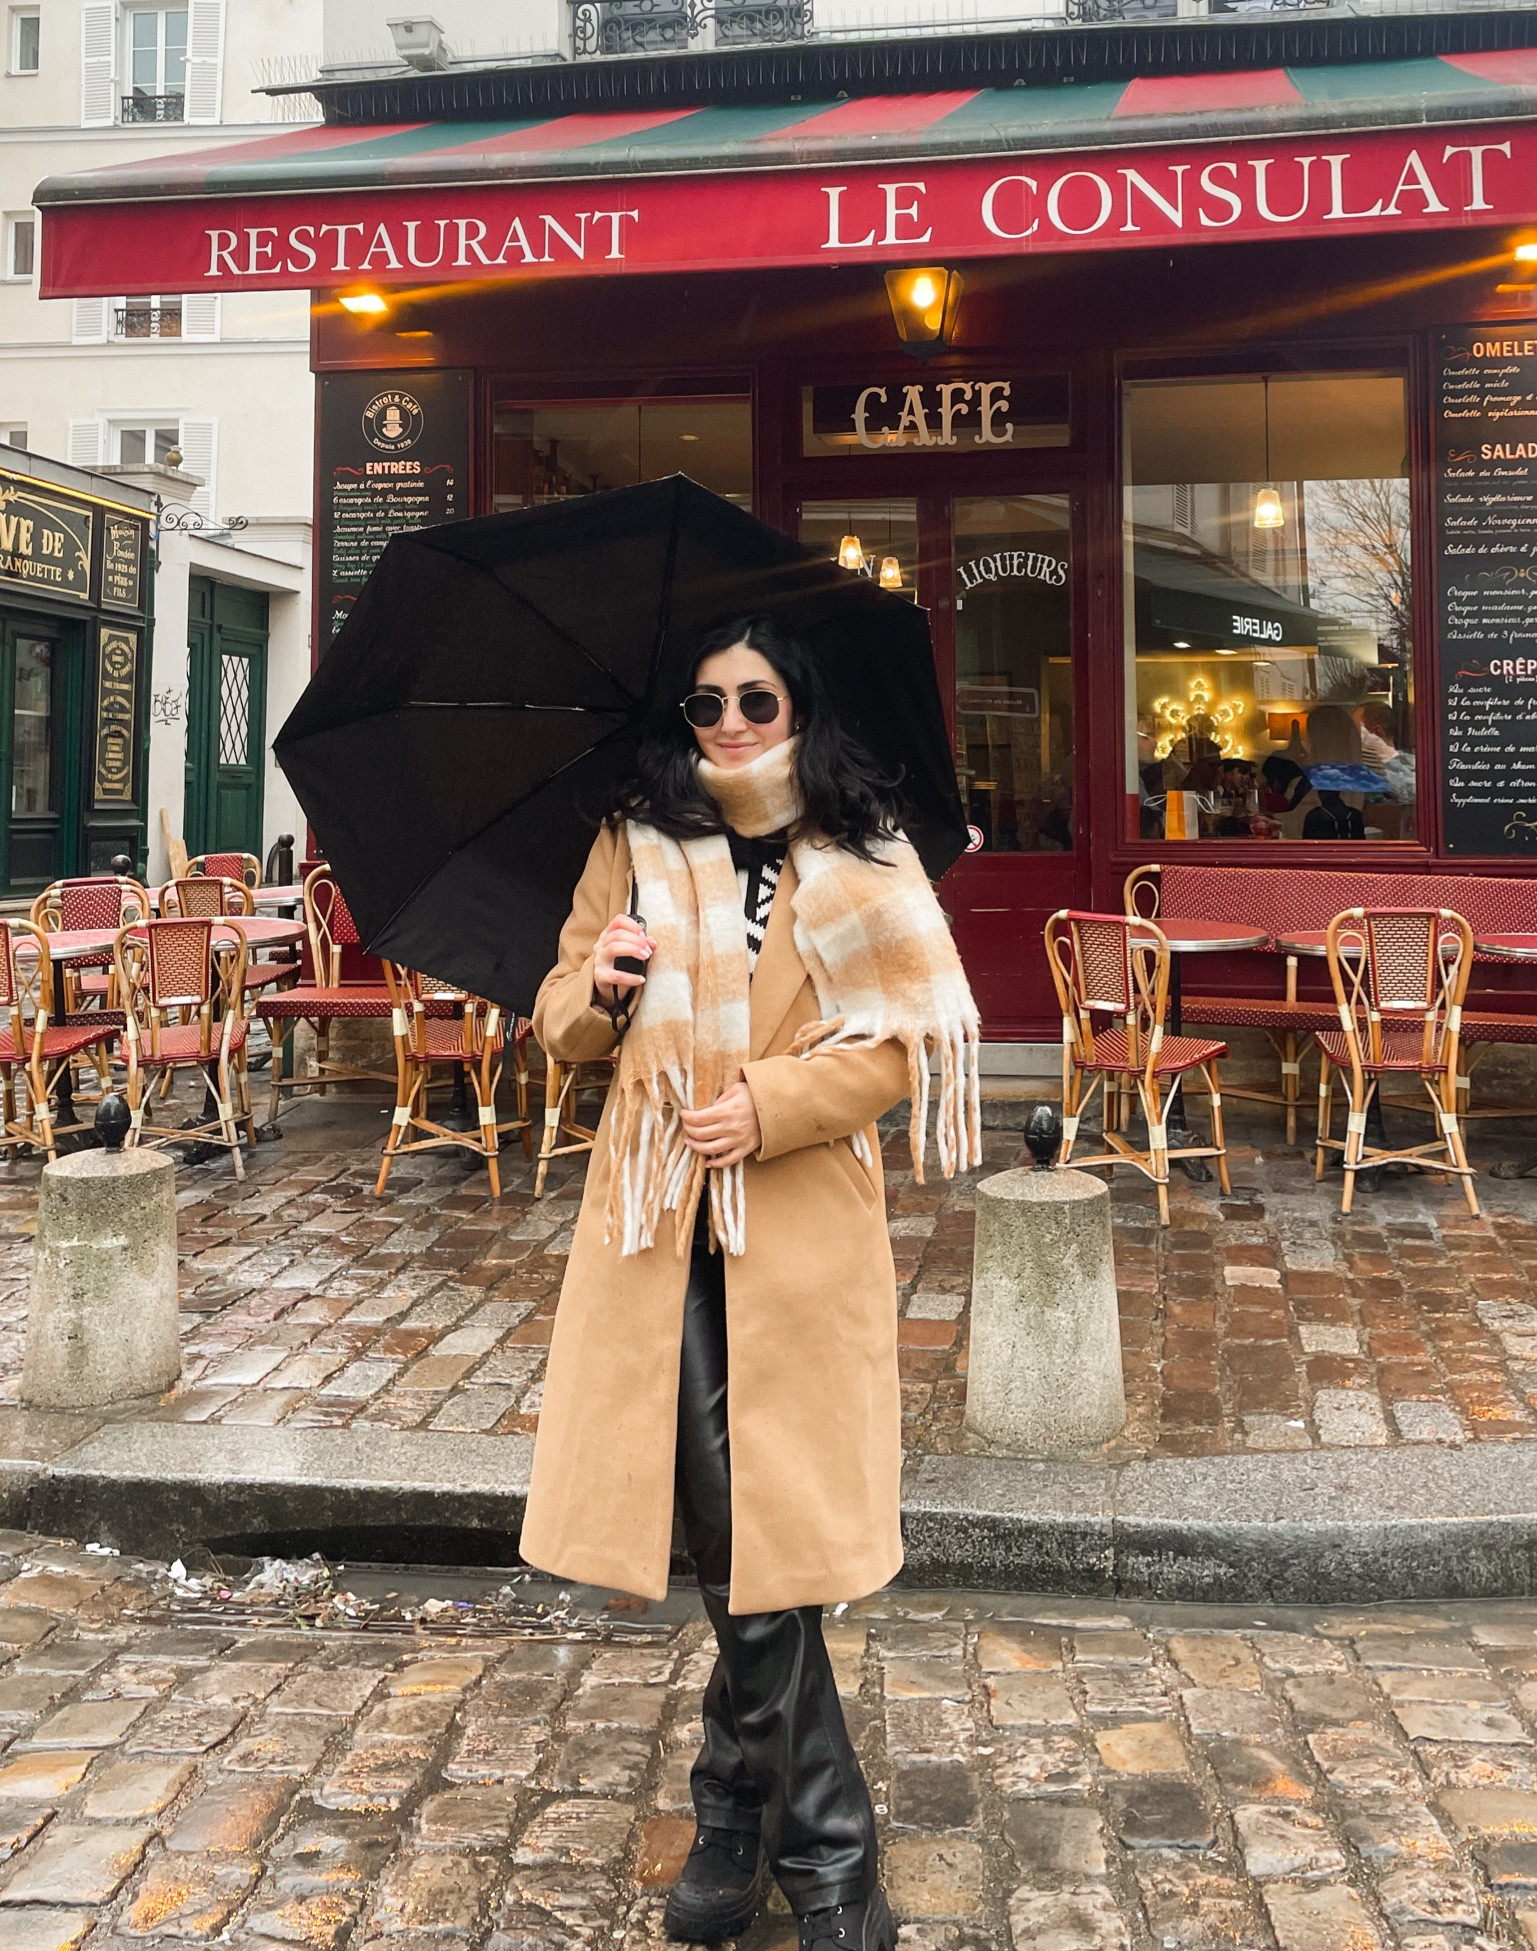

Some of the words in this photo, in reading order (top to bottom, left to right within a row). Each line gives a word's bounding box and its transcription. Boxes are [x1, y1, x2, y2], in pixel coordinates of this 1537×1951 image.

[821, 181, 932, 249] LE
[980, 141, 1511, 239] CONSULAT
[204, 209, 639, 277] RESTAURANT
[1472, 340, 1537, 358] OMELE
[1443, 367, 1480, 376] Omelette
[1443, 380, 1480, 390] Omelette
[1484, 379, 1509, 388] mixte
[365, 394, 392, 419] Bistrot
[393, 394, 401, 403] &
[402, 396, 420, 416] Café
[1443, 394, 1480, 404] Omelette
[1482, 394, 1522, 407] fromage
[1443, 409, 1481, 418] Omelette
[373, 437, 395, 450] Depuis
[365, 461, 421, 475] ENTRÉES
[1444, 468, 1475, 478] Salade
[1479, 469, 1491, 477] du
[1493, 467, 1529, 477] Consulat
[333, 480, 358, 492] Soupe
[360, 481, 365, 489] à
[366, 480, 394, 491] l'oignon
[396, 479, 424, 491] gratinée
[333, 496, 338, 504] 6
[339, 495, 372, 506] escargots
[374, 495, 383, 503] de
[386, 494, 430, 506] Bourgogne
[1444, 493, 1475, 503] Salade
[1479, 493, 1534, 507] végétarienne
[334, 511, 340, 519] 12
[342, 509, 374, 520] escargots
[376, 509, 385, 518] de
[388, 509, 429, 520] Bourgogne
[1444, 517, 1478, 527] Salade
[333, 524, 364, 533] Saumon
[41, 528, 65, 558] DE
[334, 539, 357, 548] Terrine
[360, 539, 368, 547] de
[1444, 544, 1476, 555] Salade
[1478, 544, 1488, 554] de
[1490, 543, 1518, 554] chèvre
[106, 541, 136, 560] Fondée
[333, 554, 360, 562] Cuisses
[361, 554, 370, 562] de
[332, 569, 367, 577] L'assiette
[957, 551, 1068, 590] LIQUEURS
[113, 588, 126, 598] FILS
[1447, 586, 1478, 602] Croque
[1447, 602, 1478, 616] Croque
[1447, 615, 1479, 629] Croque
[1447, 629, 1484, 639] Assiette
[1487, 630, 1498, 639] de
[1501, 630, 1508, 639] 3
[1489, 657, 1537, 676] CRÊP
[1448, 683, 1463, 693] Au
[1467, 685, 1493, 693] sucre
[1460, 696, 1471, 706] la
[1472, 697, 1511, 711] confiture
[1514, 697, 1525, 706] de
[1459, 711, 1471, 721] la
[1474, 711, 1513, 726] confiture
[1448, 726, 1463, 736] Au
[1467, 726, 1501, 736] Nutella
[1461, 743, 1471, 752] la
[1473, 743, 1501, 753] crème
[1504, 743, 1516, 752] de
[1448, 758, 1490, 770] Flambées
[1510, 760, 1536, 770] rhum
[1449, 776, 1465, 787] Au
[1509, 778, 1537, 787] citron
